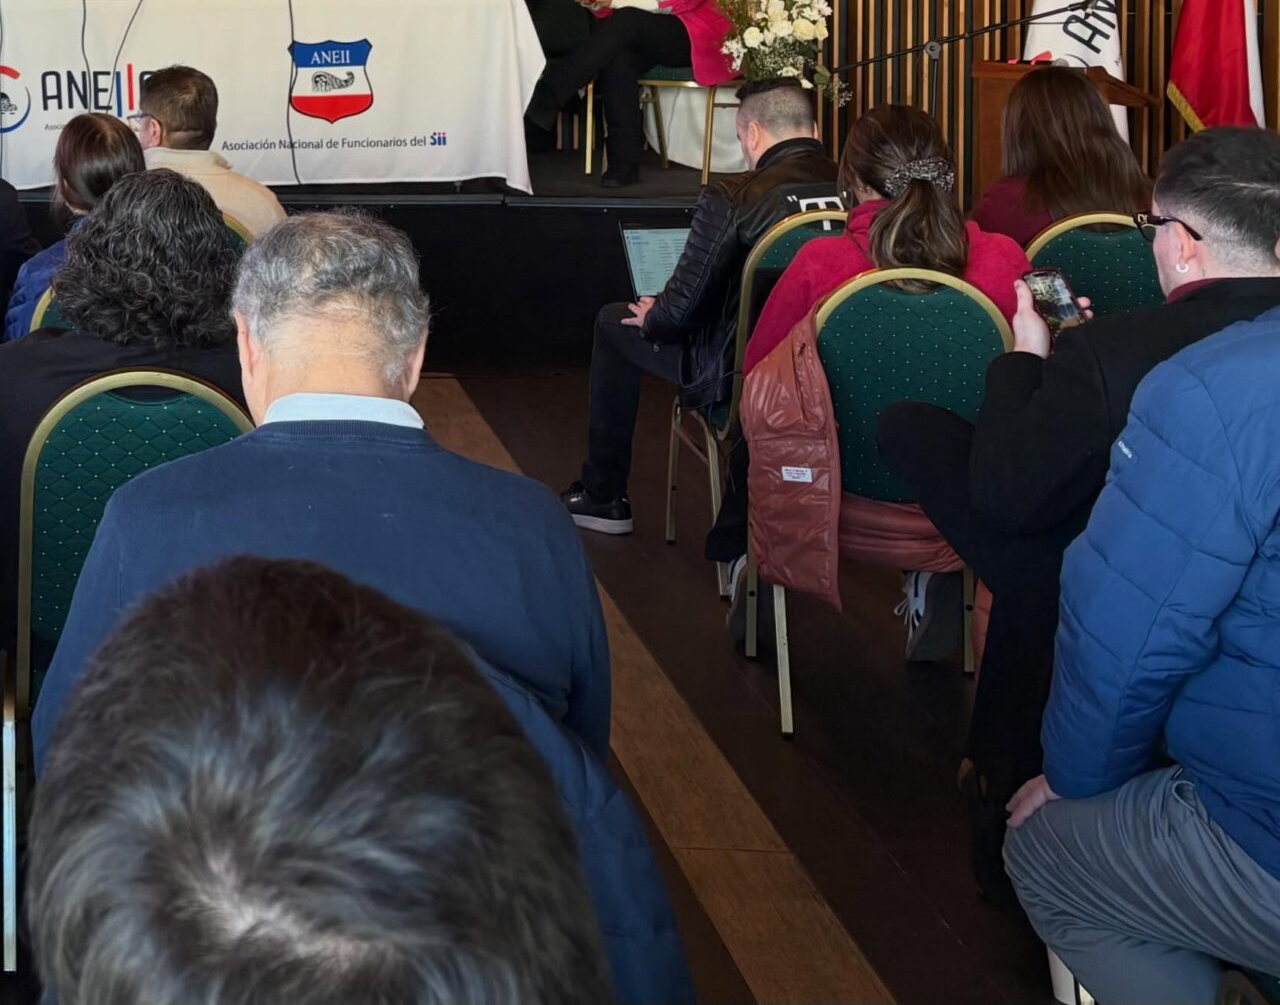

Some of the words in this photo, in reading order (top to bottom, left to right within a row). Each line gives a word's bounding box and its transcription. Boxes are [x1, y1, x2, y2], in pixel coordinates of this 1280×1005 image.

[311, 49, 351, 65] ANEII
[222, 138, 276, 151] Asociación
[279, 138, 323, 150] Nacional
[326, 138, 339, 149] de
[341, 136, 407, 148] Funcionarios
[410, 136, 426, 147] del
